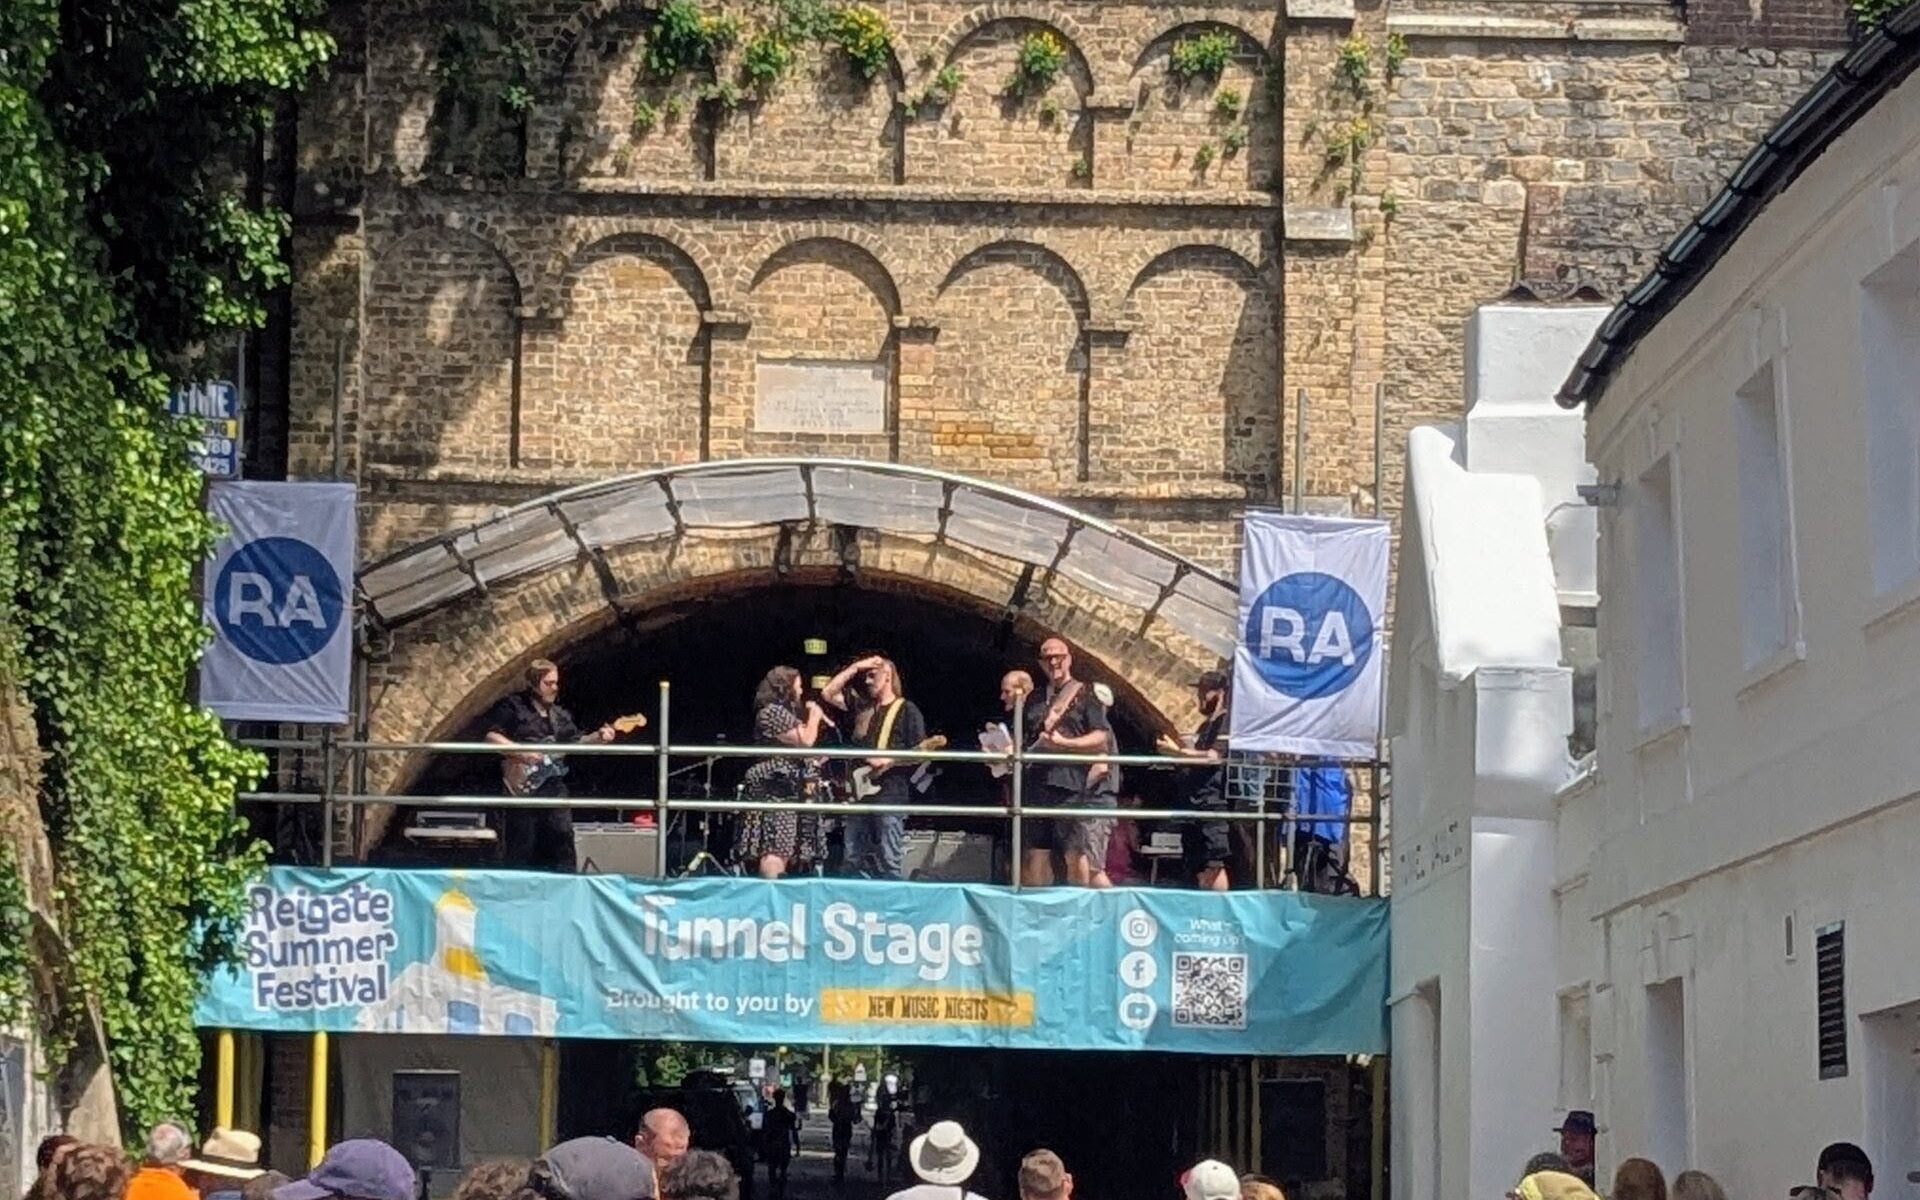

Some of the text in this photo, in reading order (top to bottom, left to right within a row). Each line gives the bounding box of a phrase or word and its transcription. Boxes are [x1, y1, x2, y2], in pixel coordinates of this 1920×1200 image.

[228, 572, 327, 629] RA
[1259, 606, 1356, 667] RA
[249, 885, 390, 935] Reigate
[247, 928, 394, 968] Summer
[643, 895, 983, 981] Tunnel Stage
[257, 965, 387, 1008] Festival
[607, 987, 813, 1017] Brought to you by
[868, 995, 989, 1020] NEW MUSIC NIGHTS
